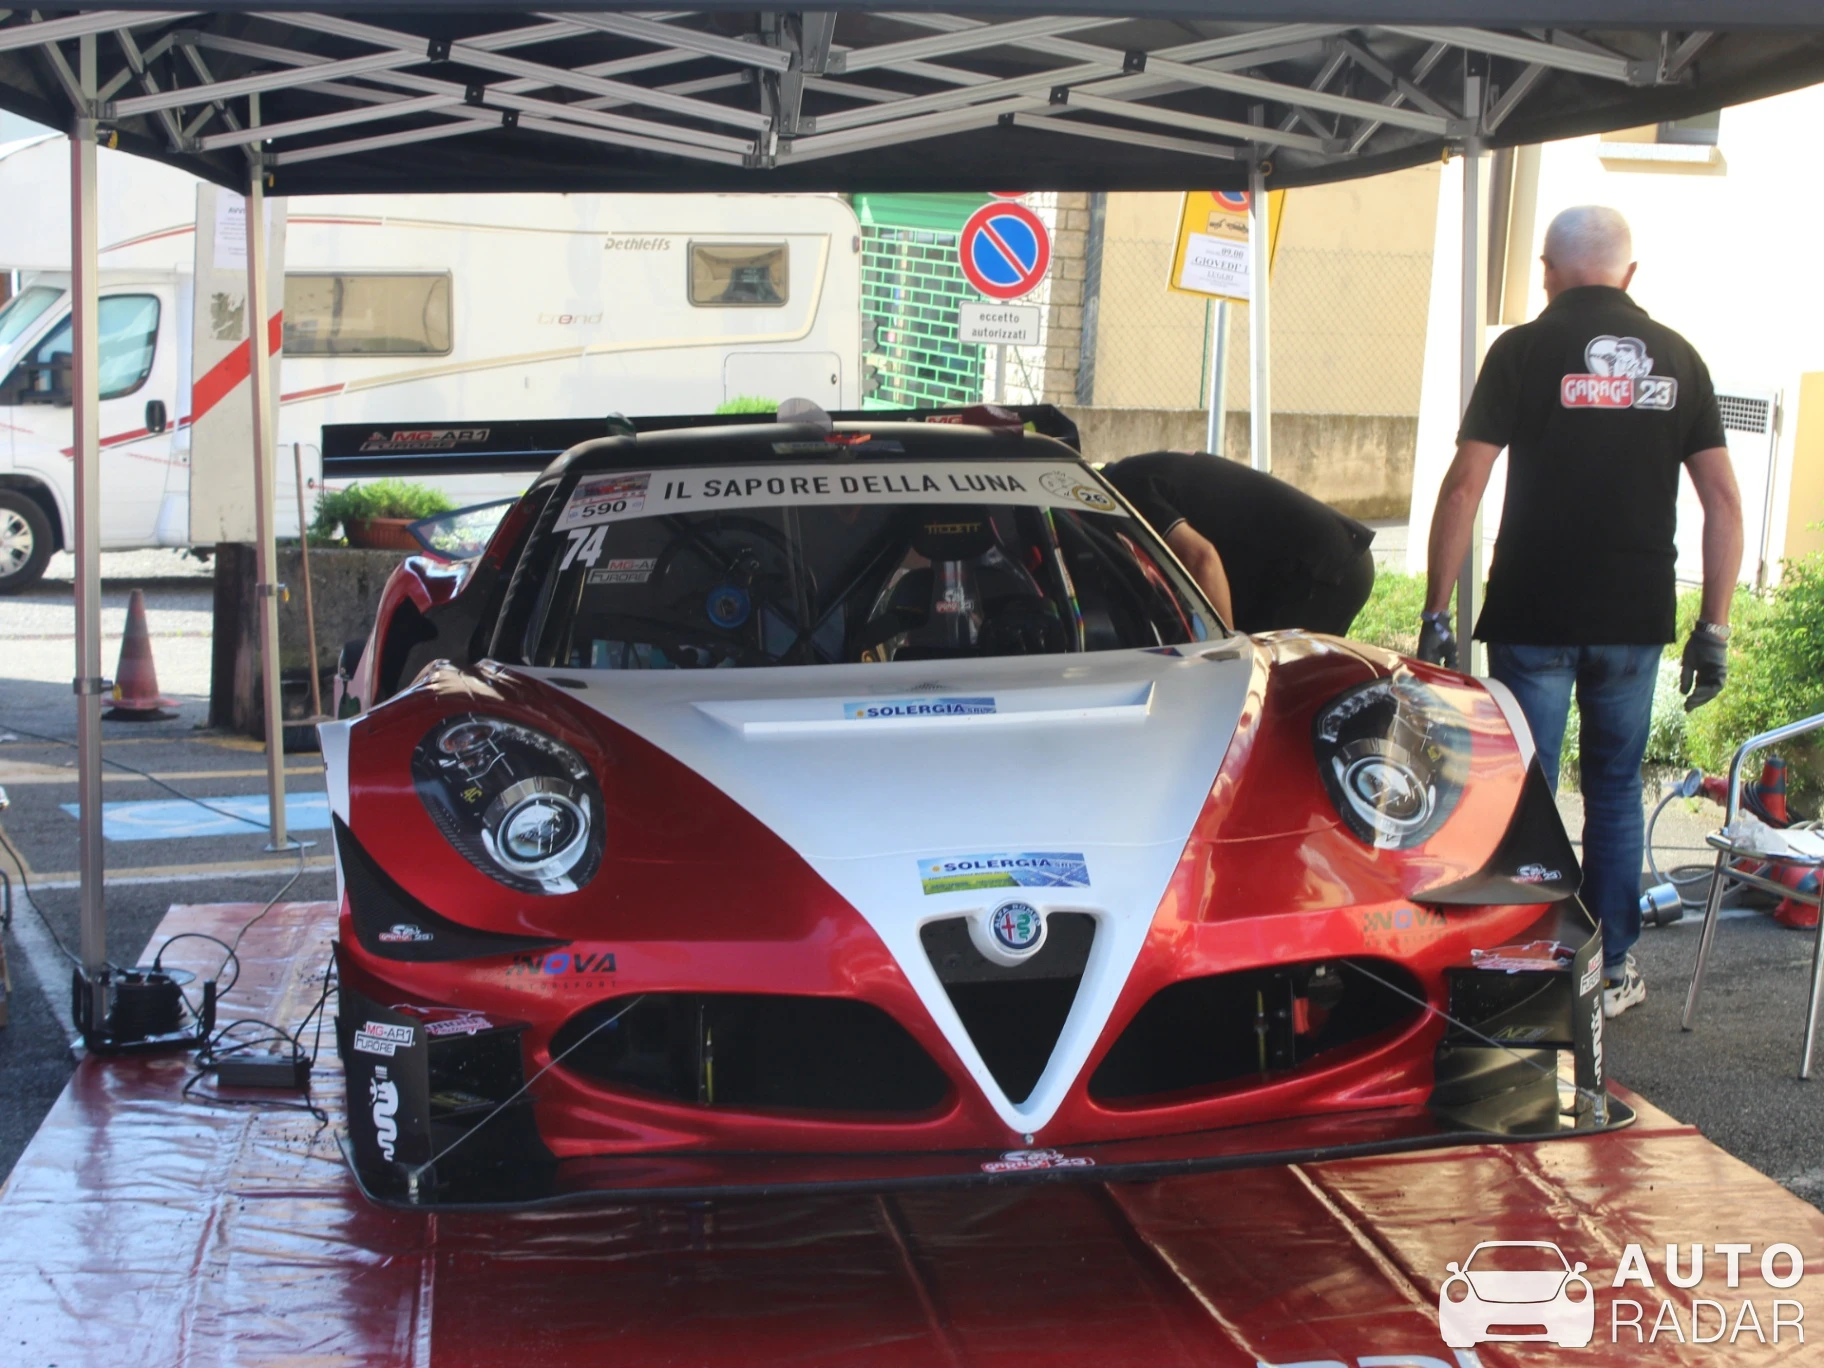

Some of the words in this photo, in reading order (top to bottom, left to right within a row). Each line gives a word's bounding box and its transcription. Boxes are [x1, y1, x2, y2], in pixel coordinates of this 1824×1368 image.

[604, 237, 671, 251] Dethleffs
[537, 312, 603, 325] trend
[979, 312, 1020, 324] eccetto
[971, 326, 1027, 340] autorizzati
[1565, 380, 1630, 404] GARAGE
[1635, 380, 1673, 405] 23
[664, 482, 692, 500] IL
[703, 477, 831, 497] SAPORE
[840, 475, 940, 493] DELLA
[948, 474, 1027, 492] LUNA
[582, 500, 627, 518] 590
[559, 525, 610, 572] 74
[867, 704, 965, 717] SOLERGIA
[944, 858, 1051, 872] SOLERGIA
[994, 907, 1009, 929] ALFA
[1012, 903, 1041, 927] ROMEO
[367, 1024, 412, 1043] MG-AR1
[356, 1035, 394, 1054] FURORE
